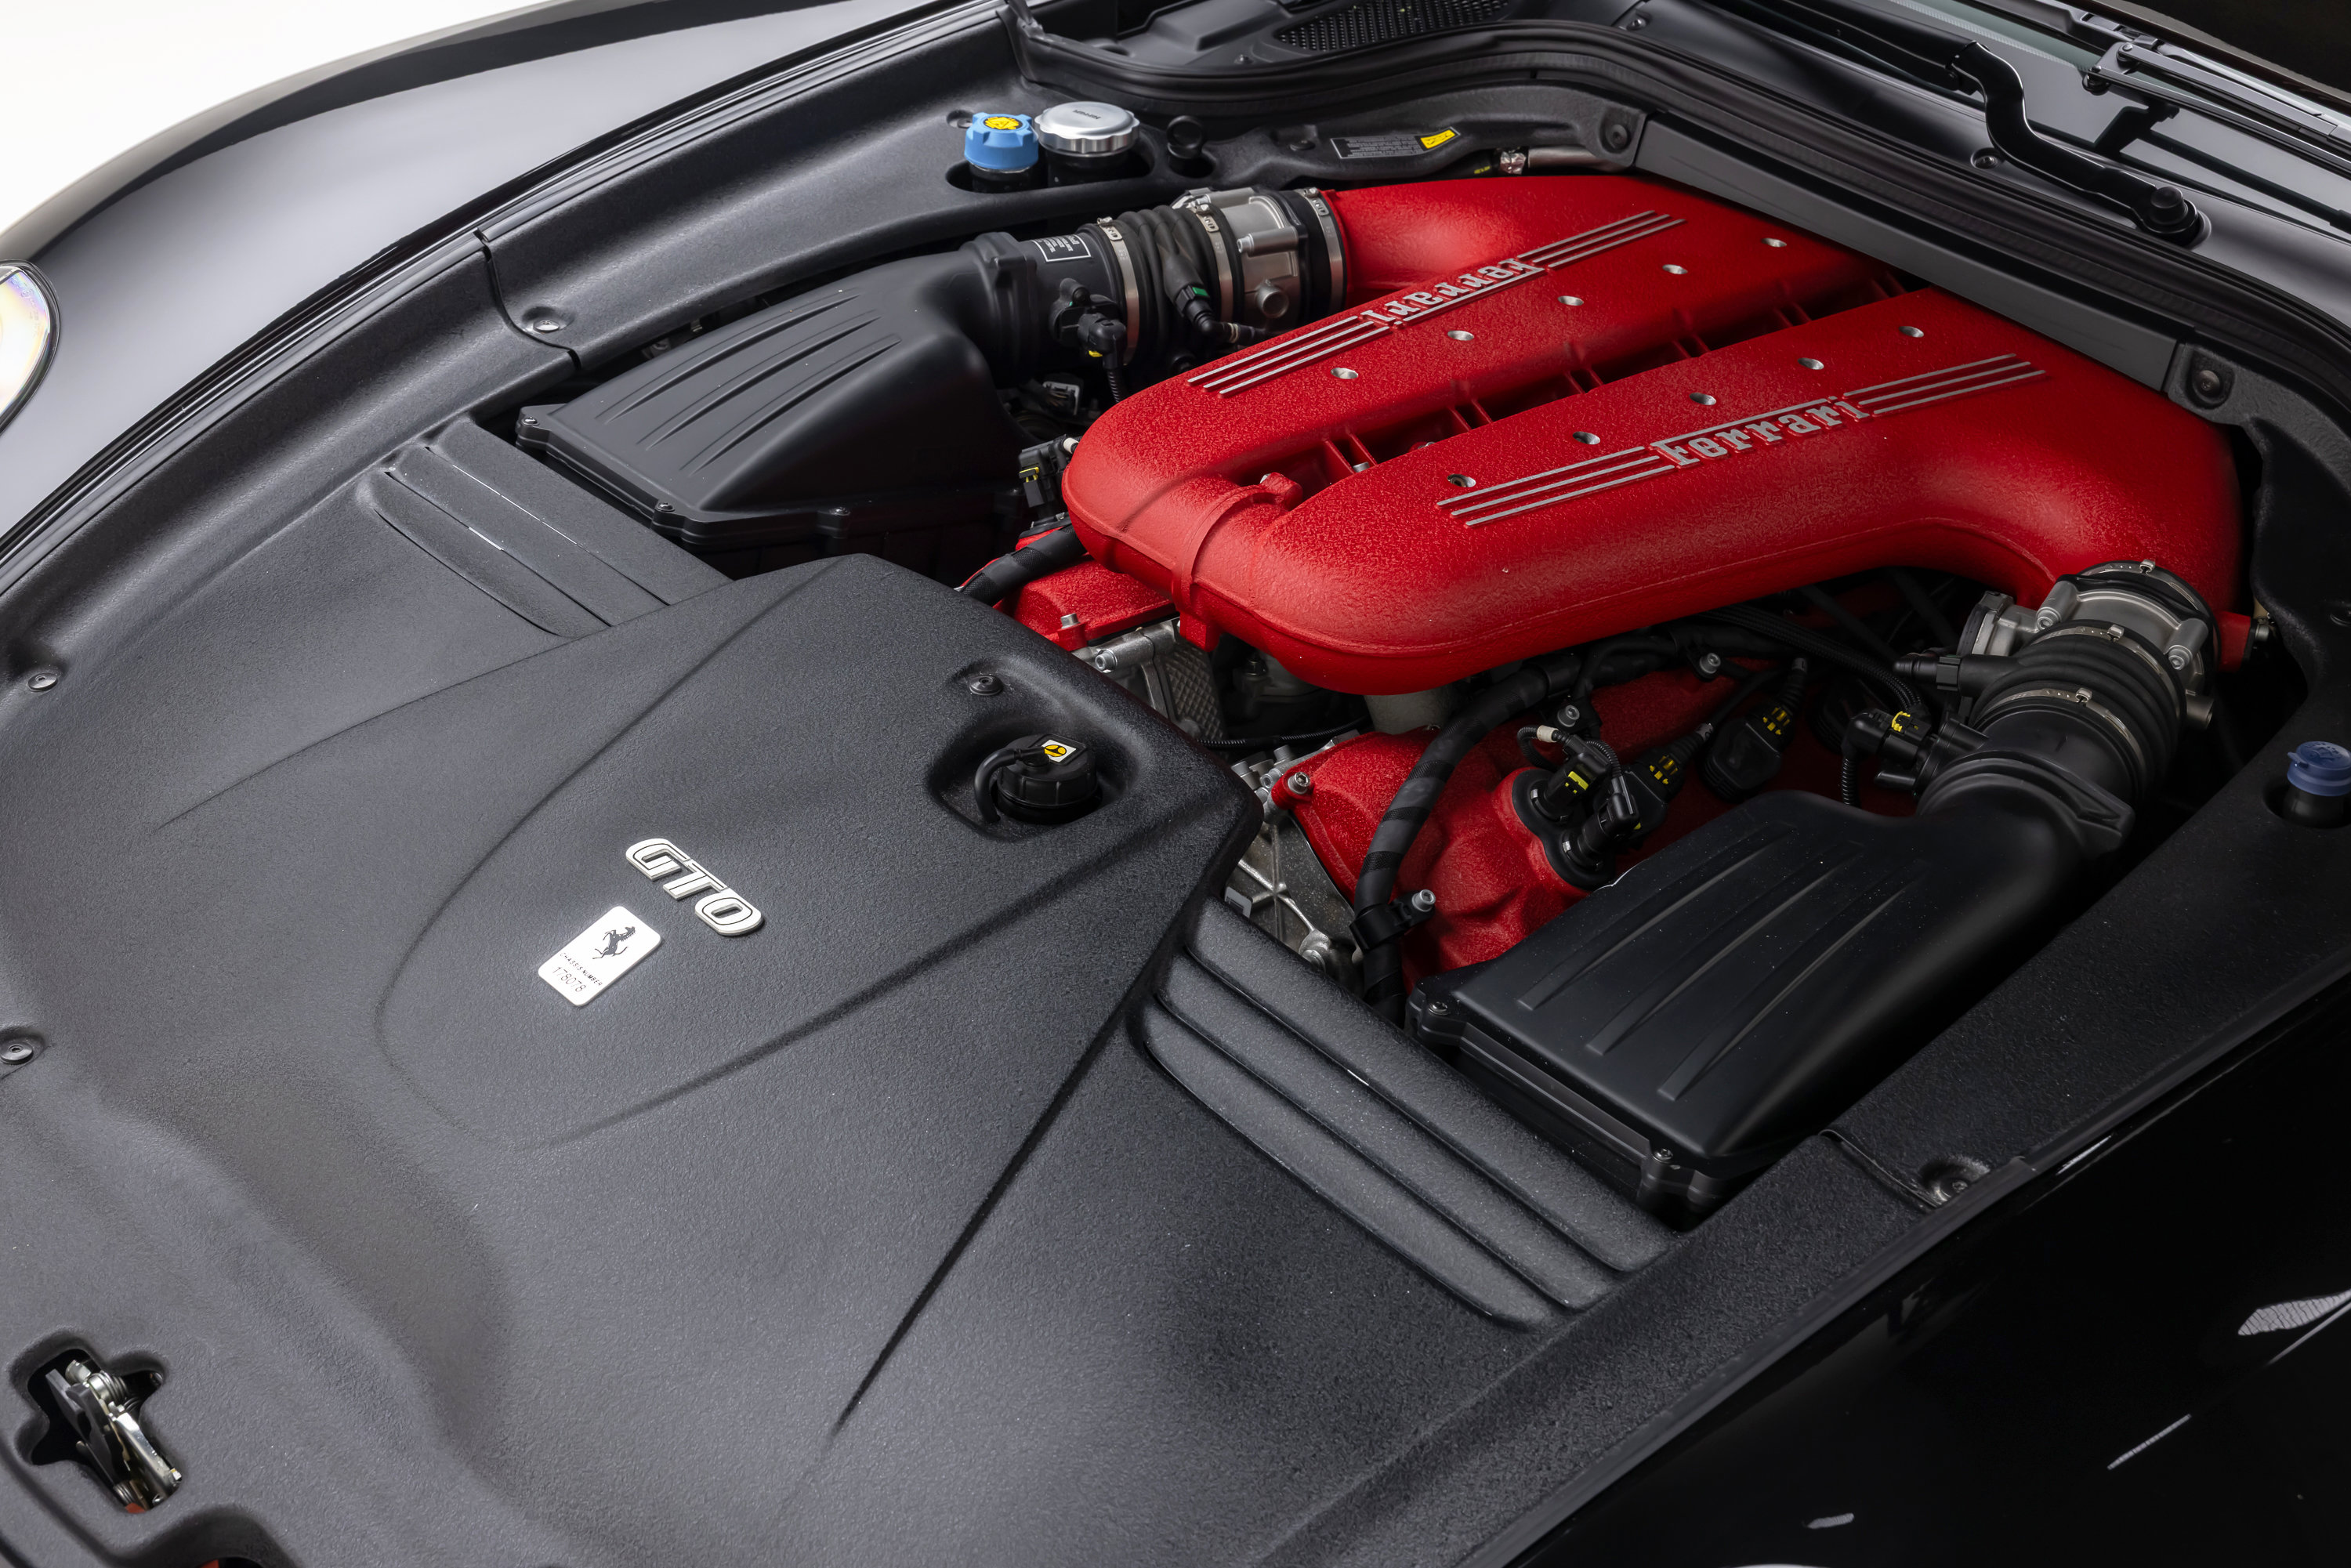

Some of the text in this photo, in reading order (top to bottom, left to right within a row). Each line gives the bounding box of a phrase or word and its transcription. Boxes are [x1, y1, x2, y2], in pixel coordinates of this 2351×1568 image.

[1360, 258, 1545, 326] Ferrari
[1650, 397, 1870, 466] Ferrari
[625, 838, 762, 936] GTO
[552, 966, 586, 993] 178078
[560, 952, 603, 986] CHASSIS NUMBER
